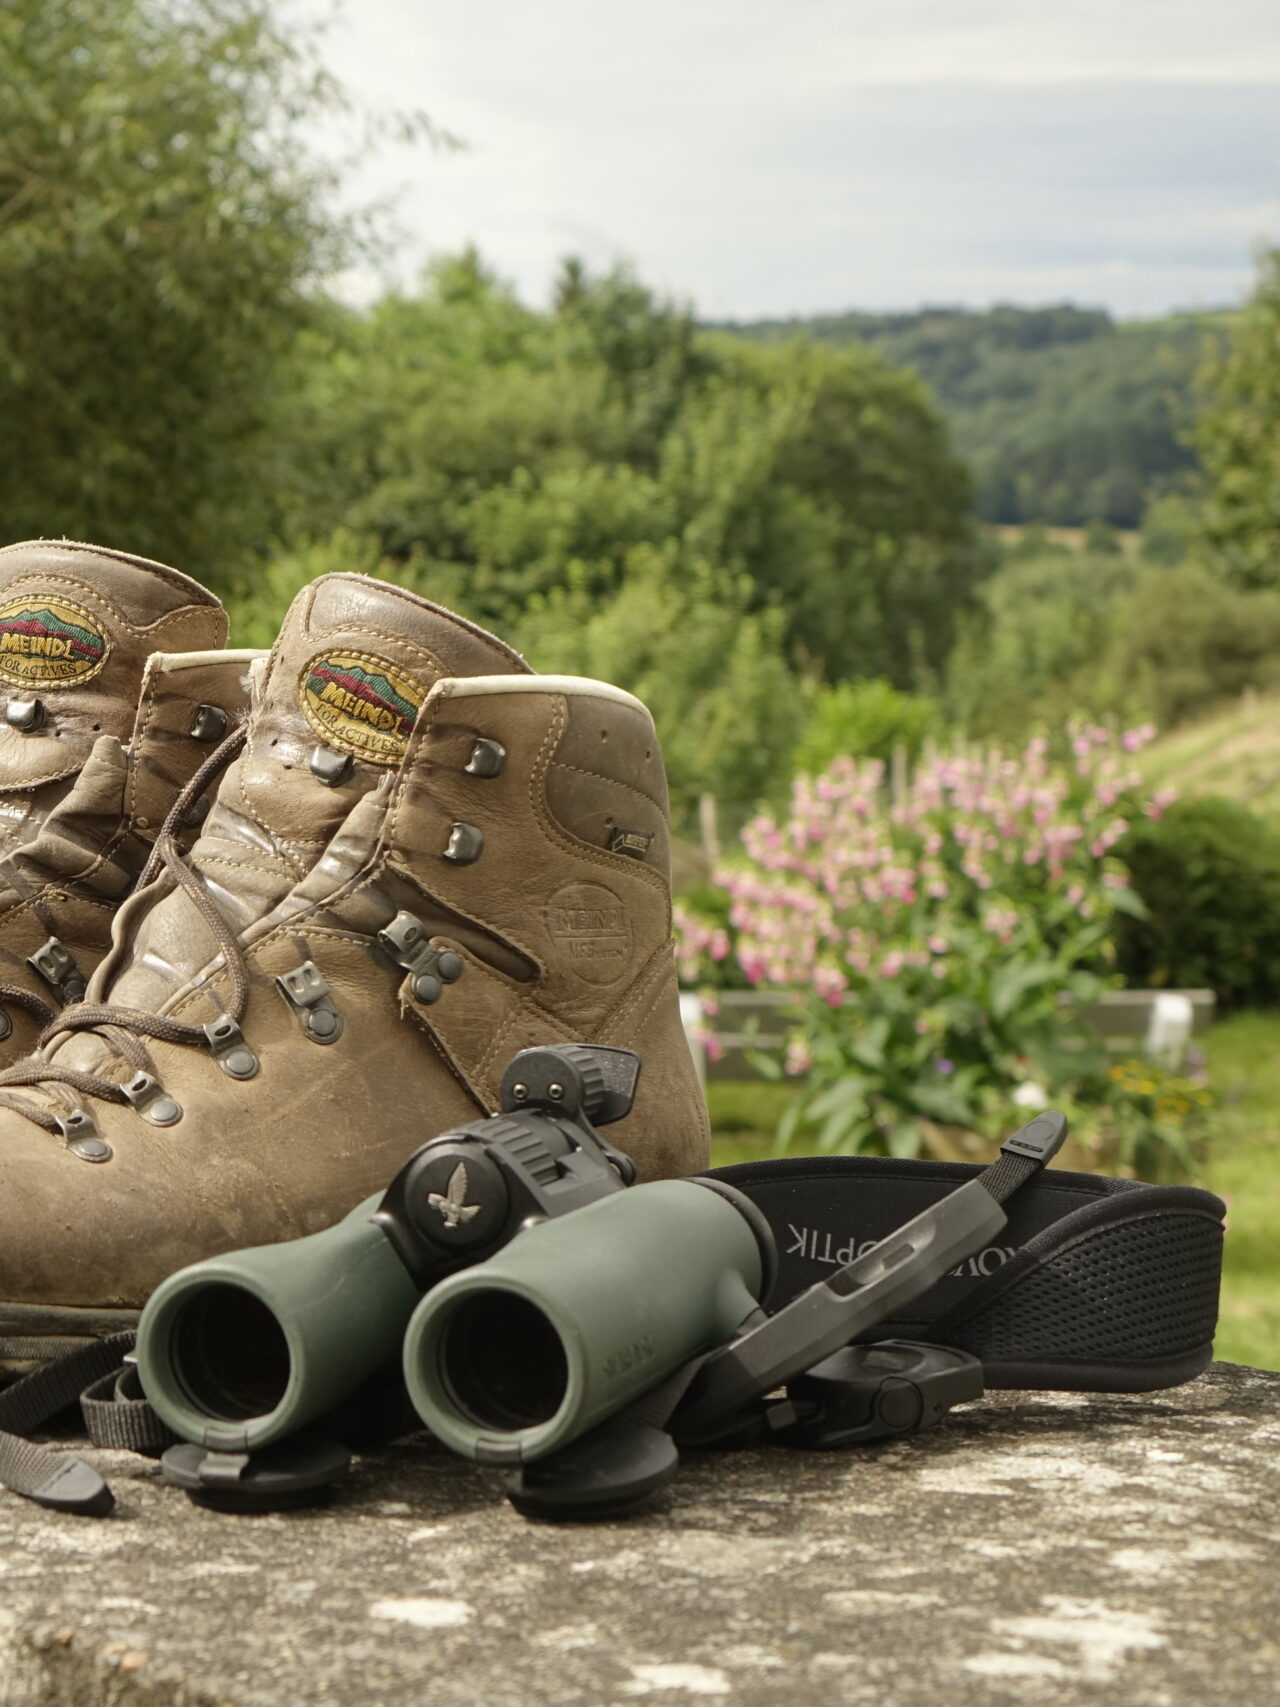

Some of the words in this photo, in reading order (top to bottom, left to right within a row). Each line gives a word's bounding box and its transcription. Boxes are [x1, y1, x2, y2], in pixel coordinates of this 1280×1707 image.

[23, 662, 78, 677] ACTIVES
[314, 703, 338, 728] FOR
[338, 724, 400, 752] ACTIVES
[320, 681, 405, 740] MEINDL
